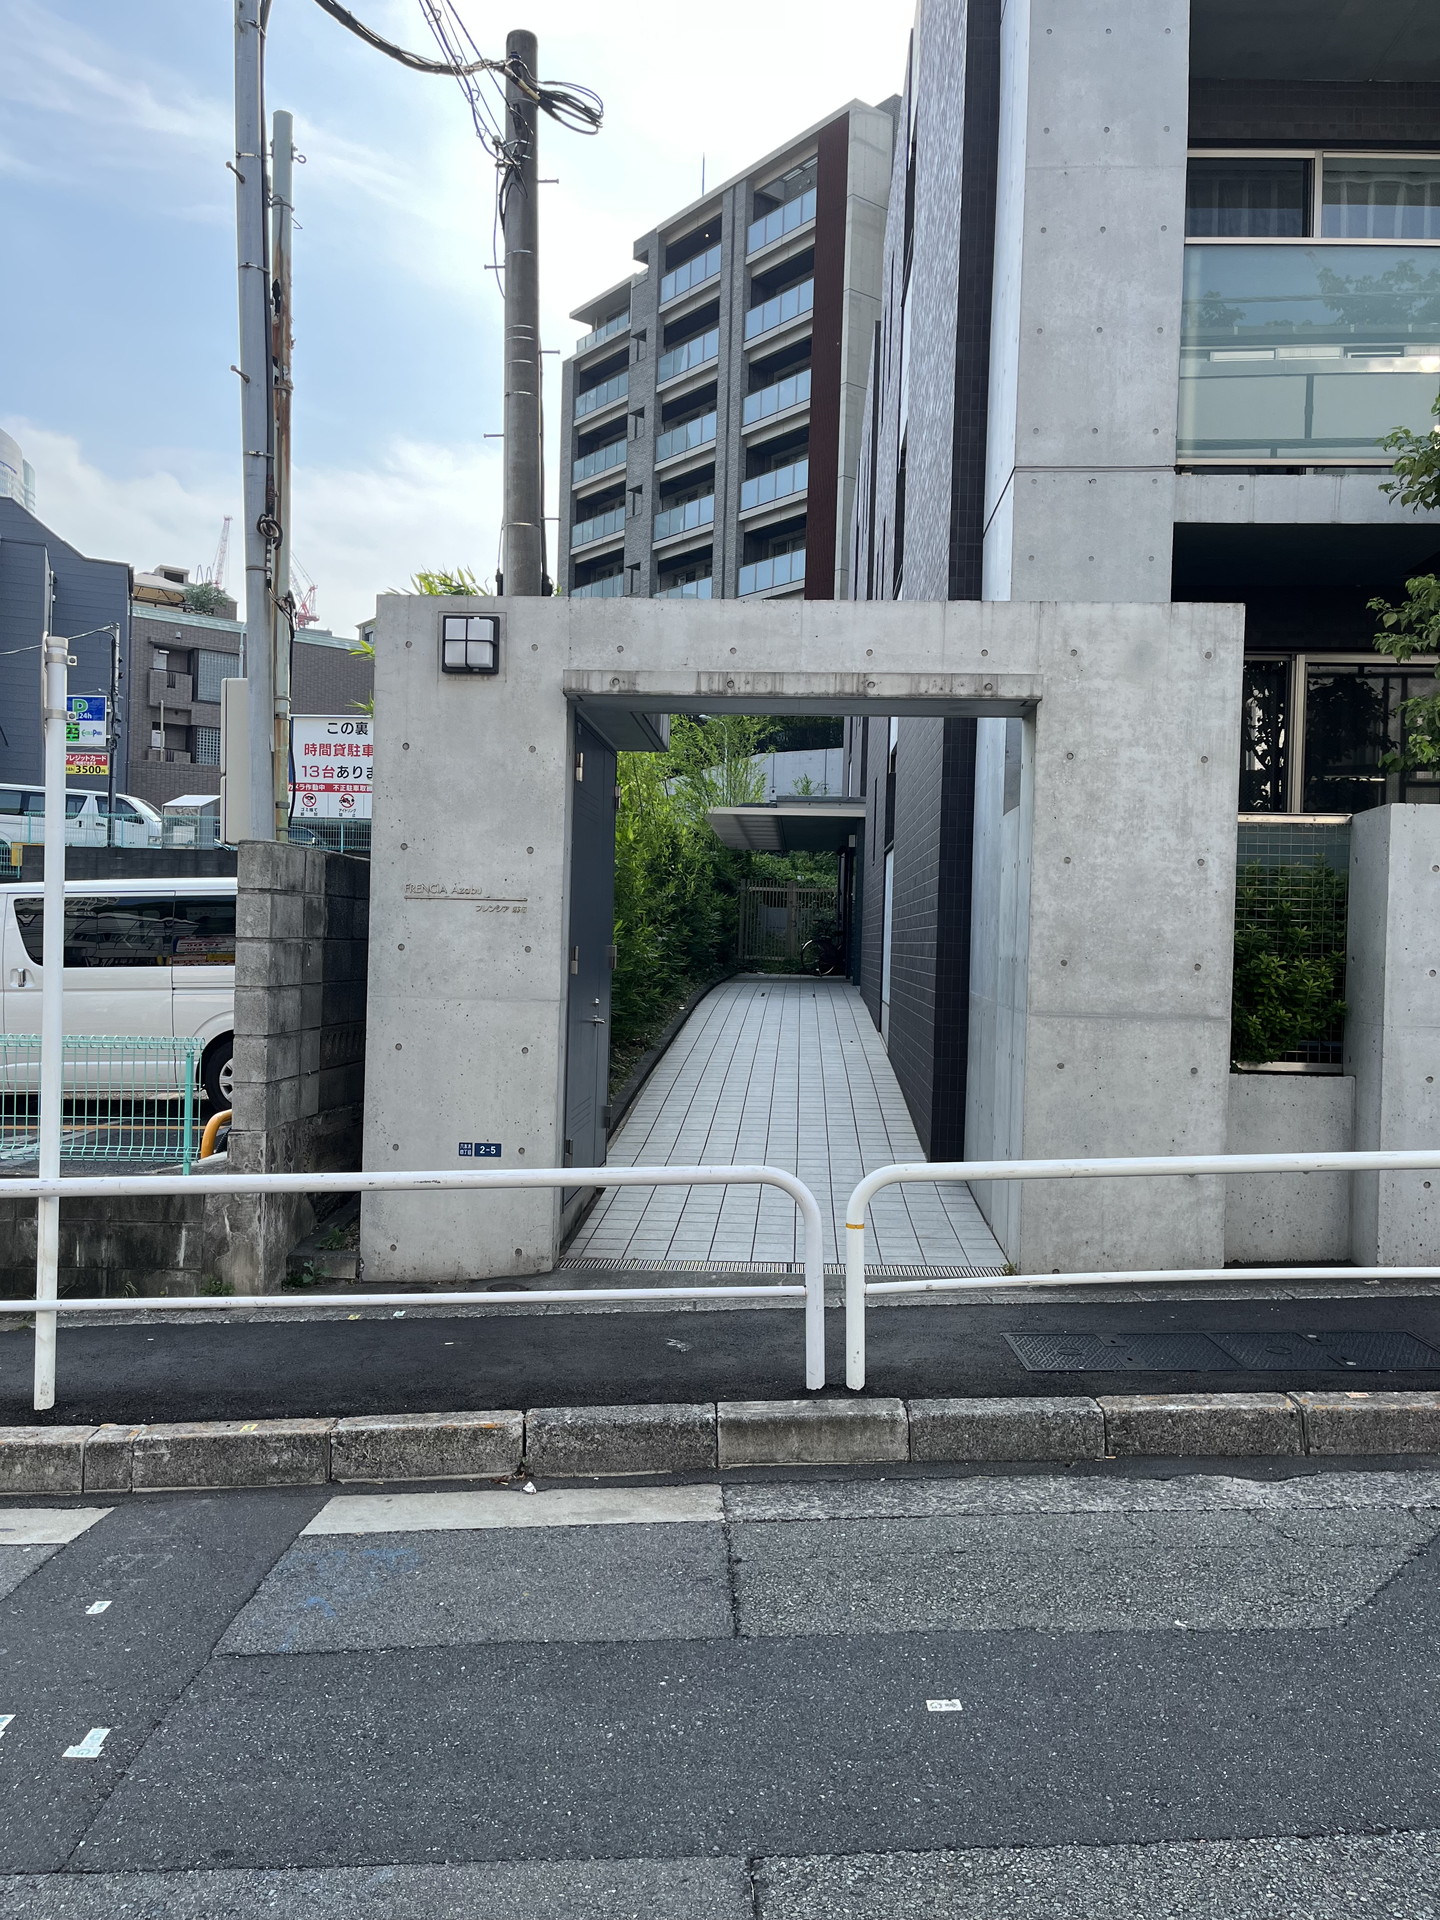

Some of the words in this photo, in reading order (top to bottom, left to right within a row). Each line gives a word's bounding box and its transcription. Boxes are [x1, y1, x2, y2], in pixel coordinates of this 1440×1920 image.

[73, 699, 88, 719] P
[327, 721, 368, 735] この裏
[304, 743, 373, 757] 時間貸駐車
[405, 883, 447, 894] FRENCIA
[451, 884, 482, 894] Azabu
[480, 1146, 496, 1154] 2-5
